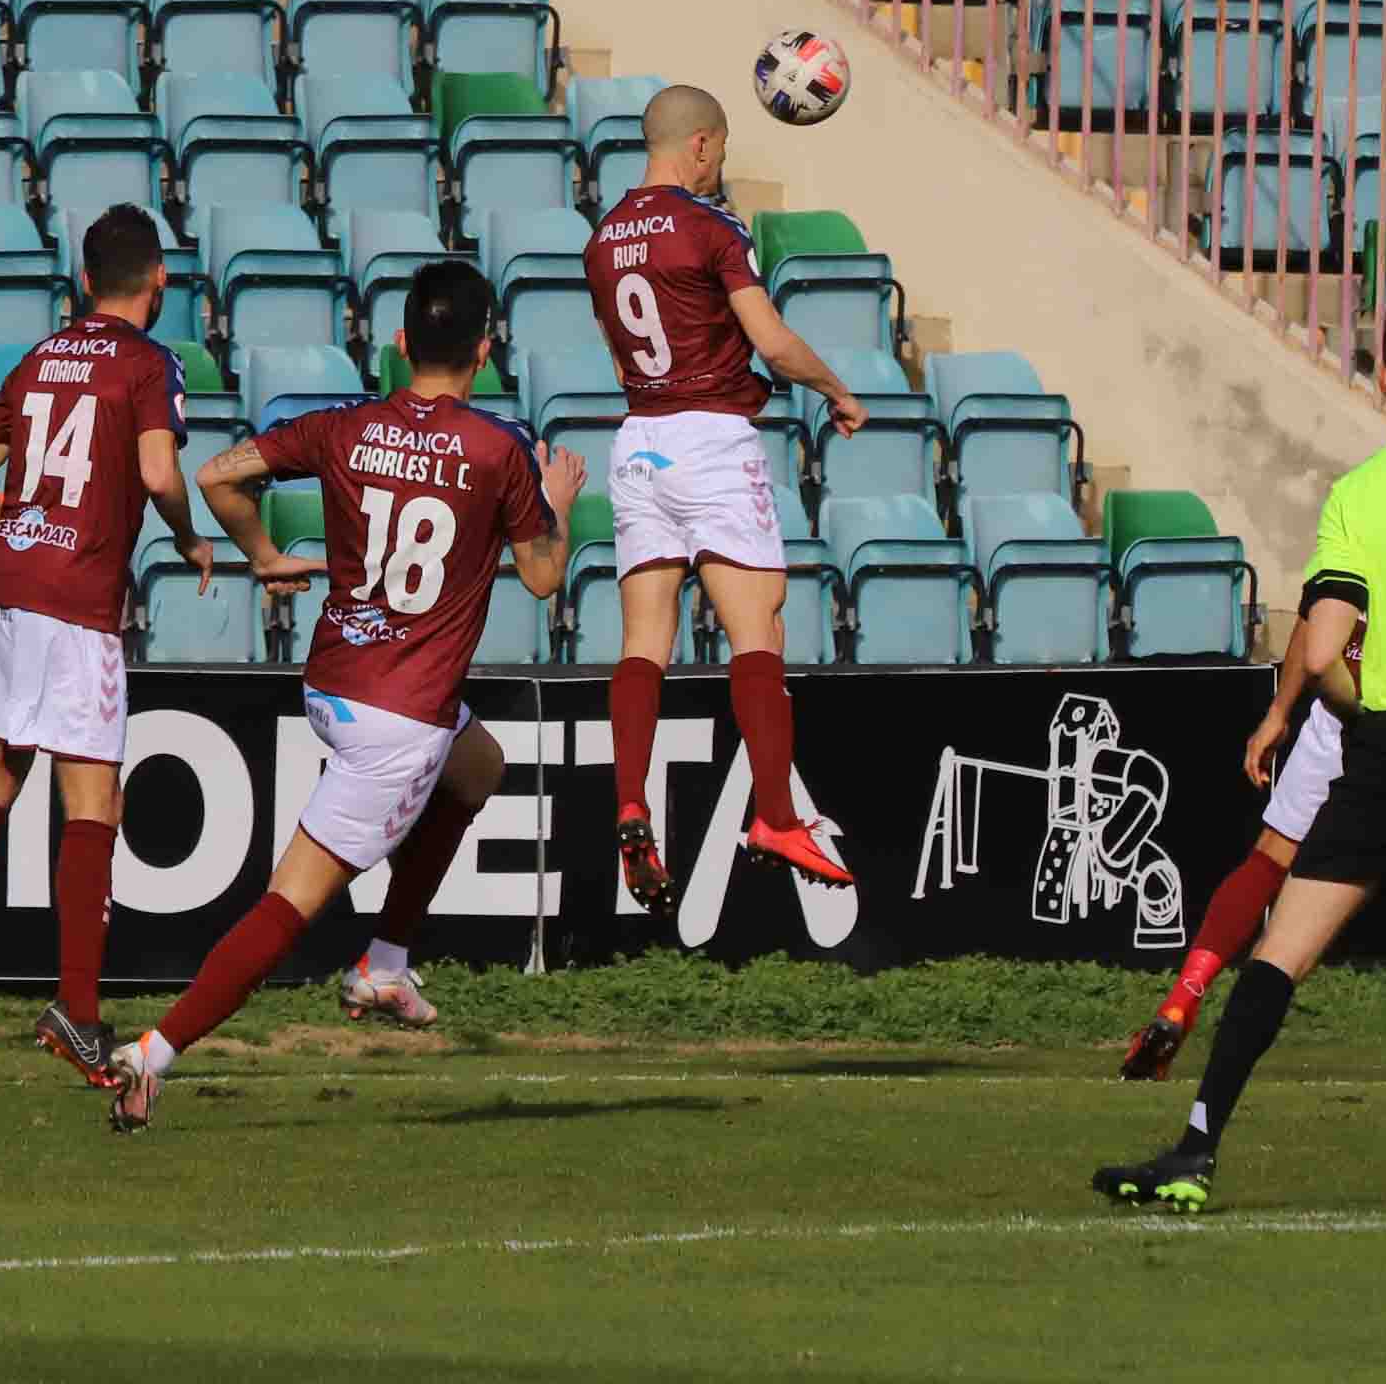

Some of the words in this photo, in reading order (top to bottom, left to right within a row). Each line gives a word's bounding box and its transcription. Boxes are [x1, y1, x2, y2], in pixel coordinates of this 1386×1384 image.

[613, 242, 648, 270] RUFO
[615, 272, 673, 378] 9
[37, 359, 93, 383] IMANOL
[19, 391, 98, 508] 14
[348, 444, 431, 483] CHARLES
[434, 459, 450, 487] L.
[457, 463, 472, 490] C.
[350, 485, 457, 615] 18
